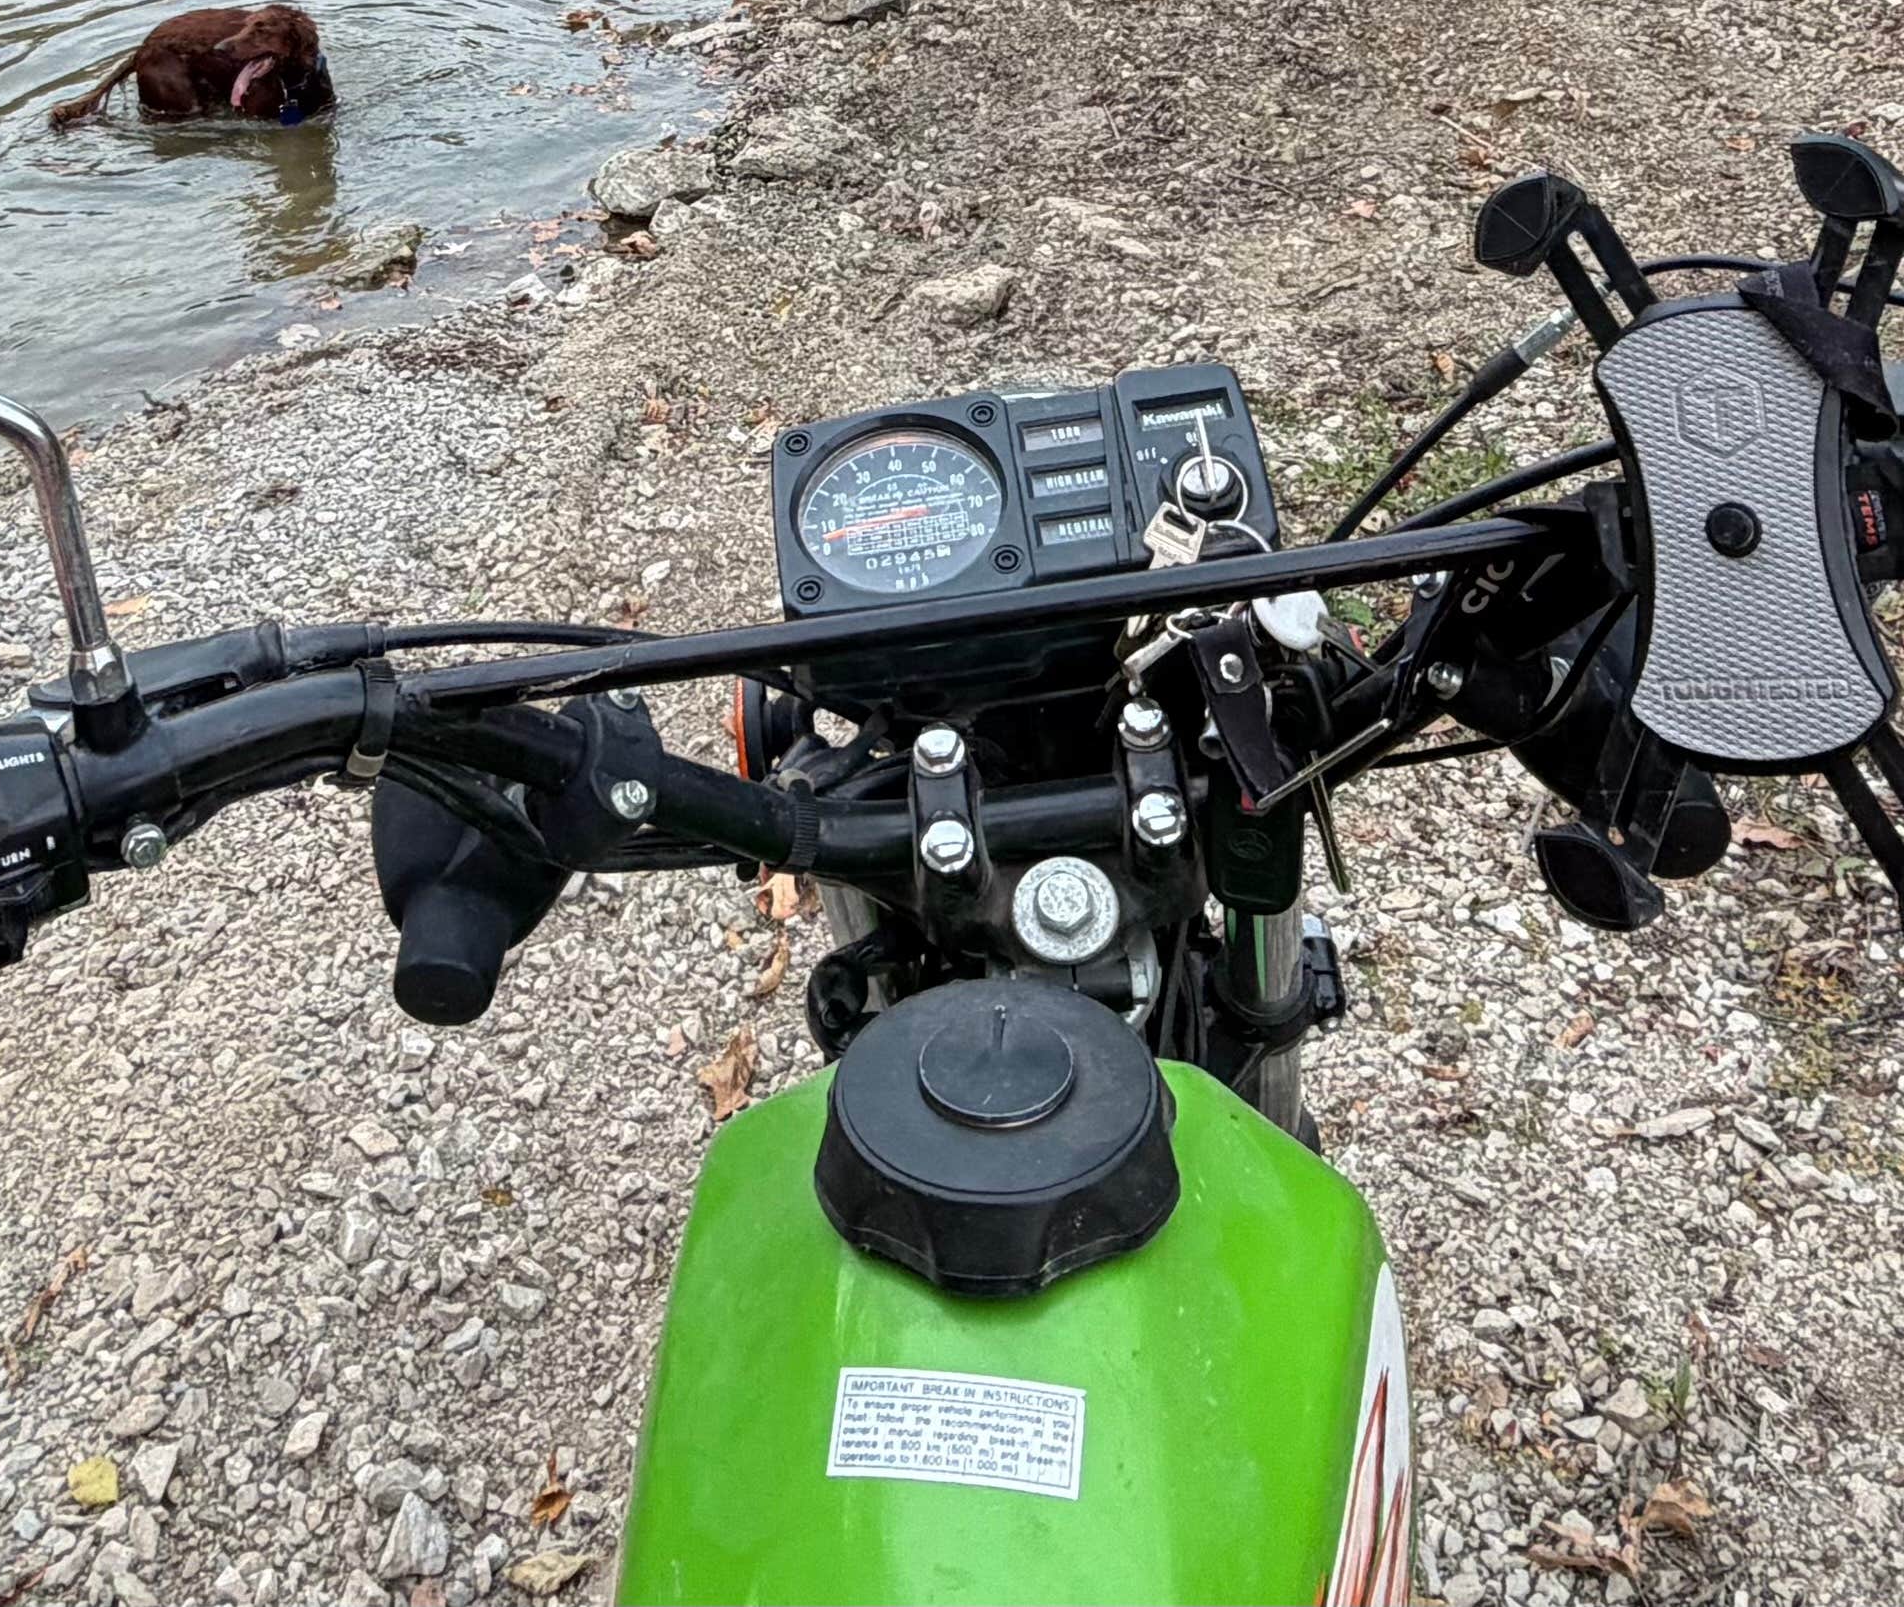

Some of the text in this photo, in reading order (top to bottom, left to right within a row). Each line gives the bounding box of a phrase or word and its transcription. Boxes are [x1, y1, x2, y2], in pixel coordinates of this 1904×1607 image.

[1142, 402, 1223, 426] Kawaski
[1051, 426, 1081, 440] TURN
[888, 460, 902, 472] 40
[922, 460, 937, 473] 50
[856, 471, 870, 484] 30
[950, 473, 964, 486] 60
[1045, 469, 1104, 490] HIGH BEAM
[832, 493, 848, 506] 20
[968, 495, 983, 508] 70
[821, 519, 836, 533] 10
[970, 523, 985, 538] 80
[1058, 517, 1110, 536] NEUTRAL
[823, 544, 831, 556] 0
[851, 1380, 914, 1393] IMPORTANT
[983, 1390, 1070, 1411] INSTRUCTIONS
[848, 1398, 858, 1409] To
[864, 1401, 895, 1410] ensure
[901, 1403, 932, 1413] proper
[938, 1405, 972, 1416] vehicle
[1053, 1420, 1070, 1430] you
[844, 1413, 867, 1422] must
[877, 1412, 905, 1424] follow
[915, 1416, 931, 1426] the
[1053, 1431, 1069, 1442] the
[888, 1428, 923, 1437] manual
[933, 1430, 979, 1445] regarding
[884, 1440, 894, 1450] at
[926, 1441, 941, 1452] km
[1000, 1451, 1020, 1461] and
[840, 1453, 881, 1463] operation
[884, 1455, 896, 1464] up
[900, 1454, 910, 1463] to
[946, 1457, 959, 1467] km
